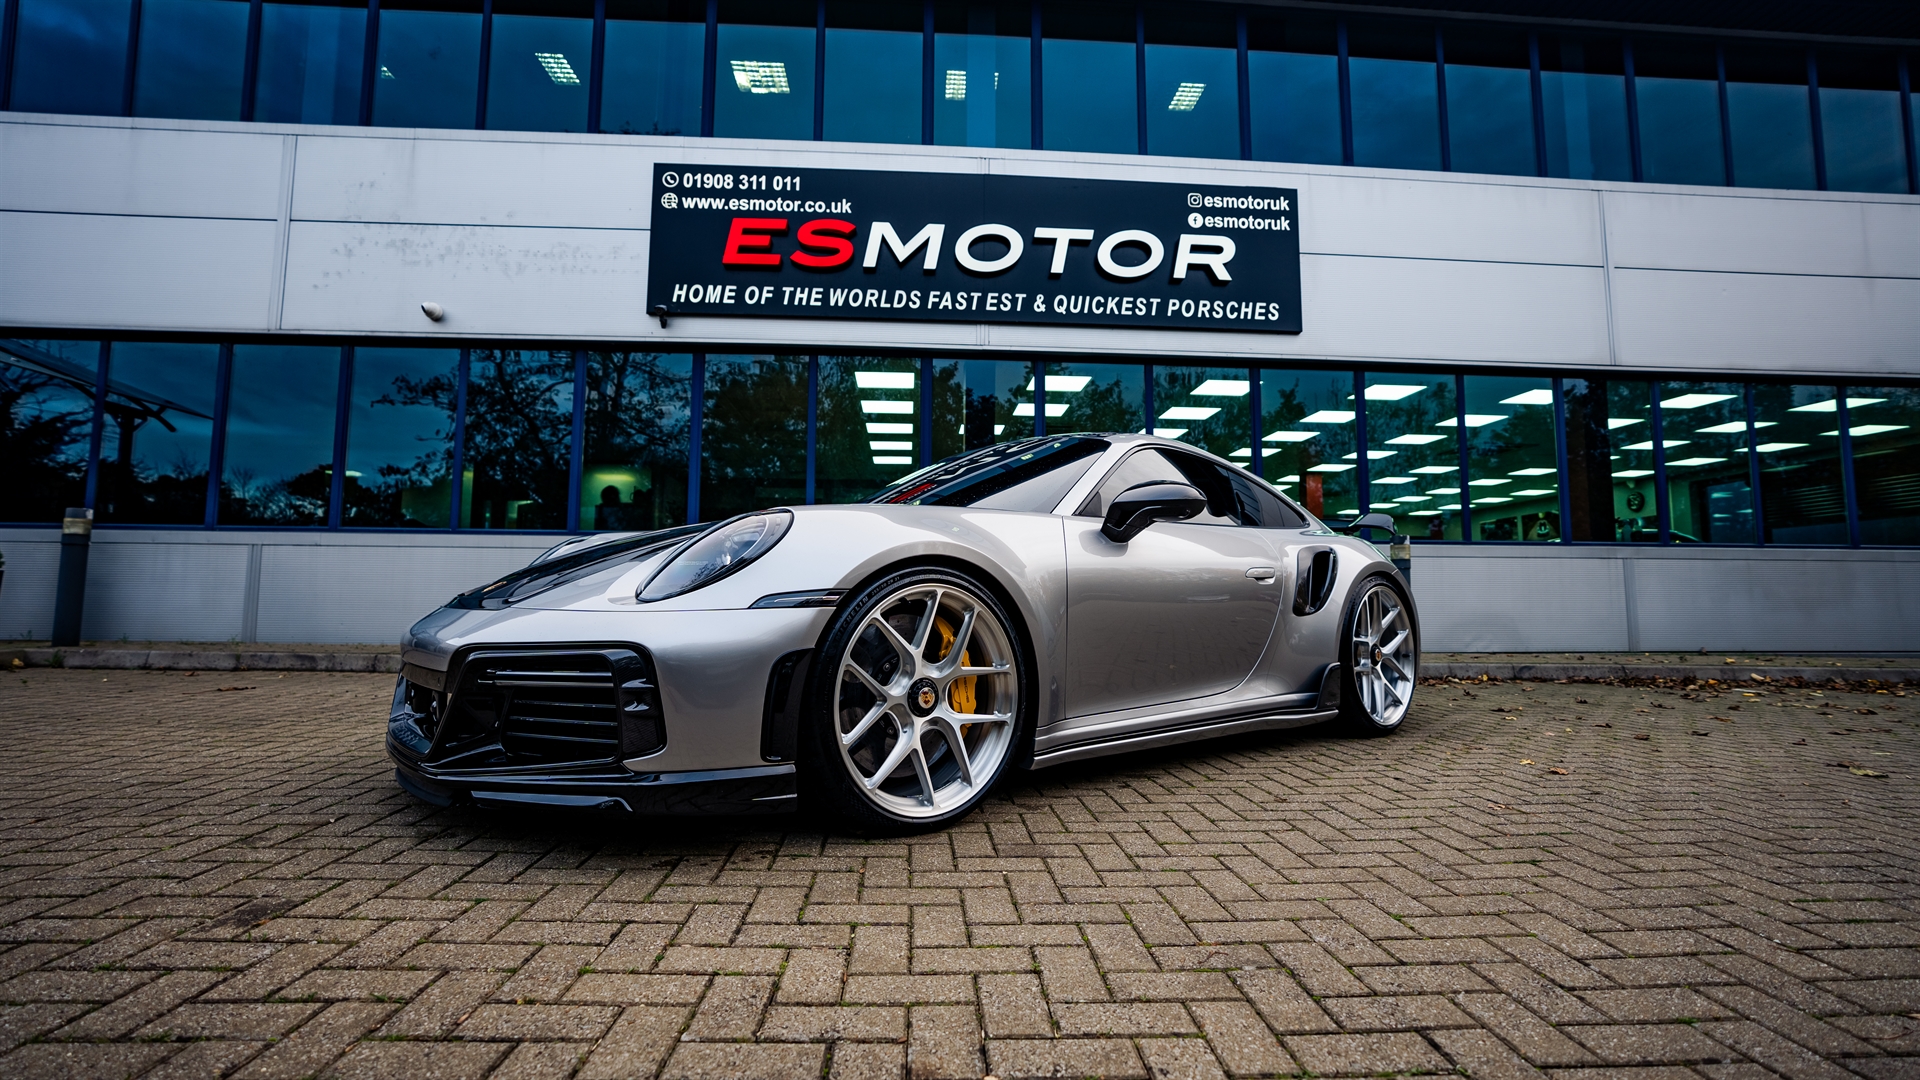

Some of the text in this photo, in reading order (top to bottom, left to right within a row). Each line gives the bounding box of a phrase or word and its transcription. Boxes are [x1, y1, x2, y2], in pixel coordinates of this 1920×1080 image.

[683, 172, 801, 192] 01908 311 011
[682, 196, 852, 214] www.esmotor.co.uk
[1203, 195, 1290, 211] esmotoruk
[1204, 215, 1291, 231] esmotoruk
[722, 217, 1237, 281] ESMOTOR
[672, 283, 1280, 321] HOME OF THE WORLDS FASTEST & QUICKEST PORSCHES
[835, 595, 869, 641] MICHELIN
